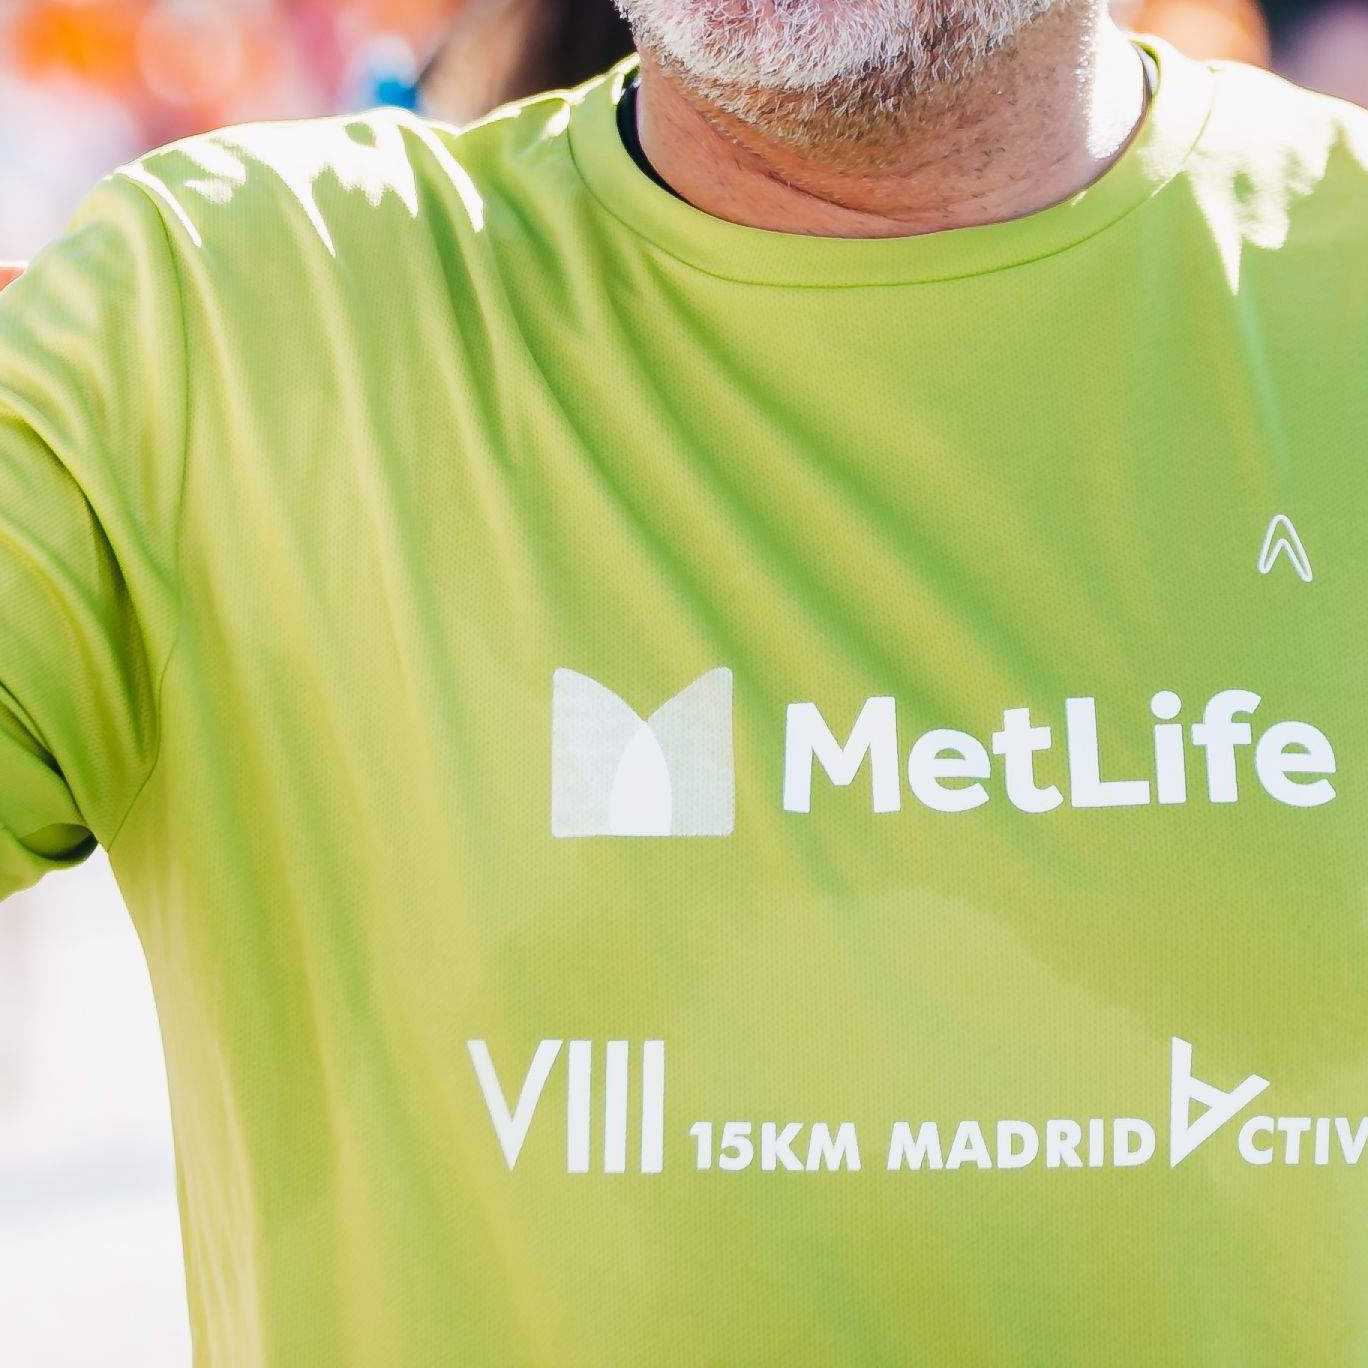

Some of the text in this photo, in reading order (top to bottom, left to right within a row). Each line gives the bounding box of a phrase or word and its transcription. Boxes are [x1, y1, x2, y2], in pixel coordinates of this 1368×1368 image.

[782, 689, 1337, 814] MetLife
[467, 1039, 665, 1174] VIII
[689, 1121, 862, 1171] 15KM
[887, 1117, 1156, 1171] MADRID
